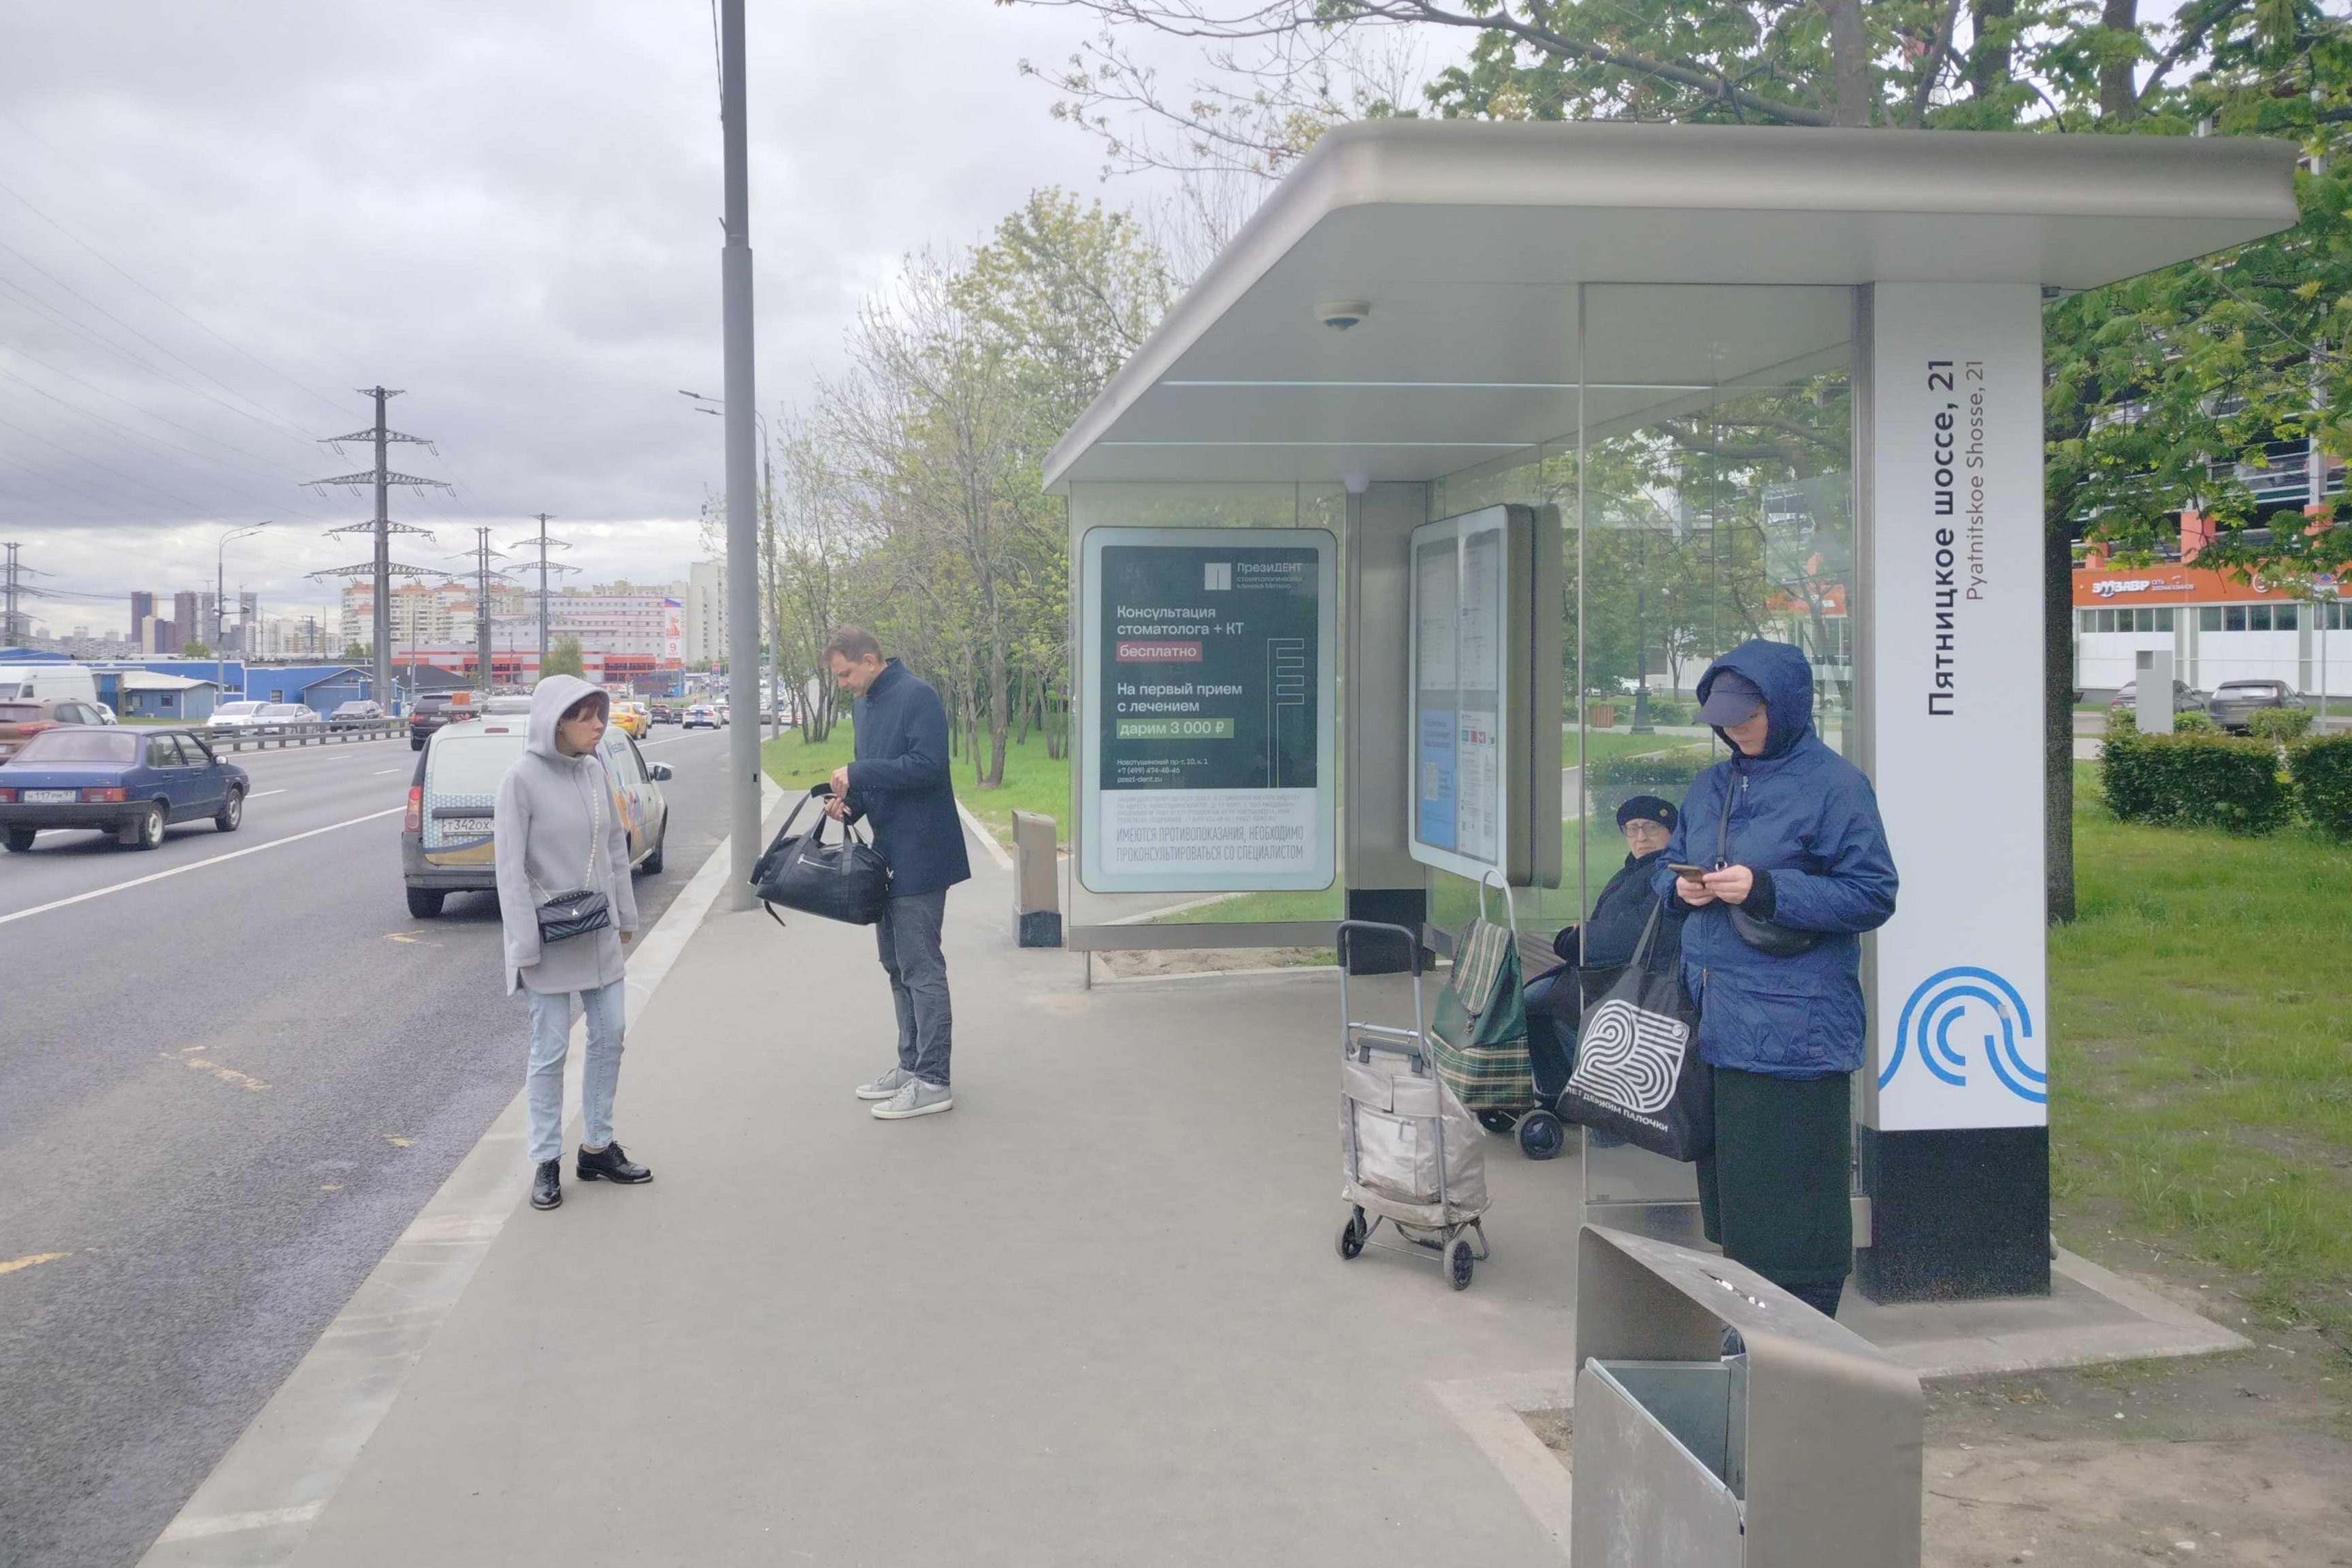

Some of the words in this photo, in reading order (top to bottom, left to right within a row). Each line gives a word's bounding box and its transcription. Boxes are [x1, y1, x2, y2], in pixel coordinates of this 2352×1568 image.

[1928, 361, 1953, 391] 21
[1965, 361, 1983, 380] 21
[1965, 387, 1986, 468] Shosse,
[1934, 403, 1959, 515] шоссе,
[1965, 476, 1987, 600] Pyatnitskoe
[1237, 562, 1303, 575] ПрезиДЕНТ
[1117, 606, 1216, 619] Консультация
[1928, 527, 1958, 715] Пятницкое
[1117, 624, 1209, 635] стоматолога
[1226, 622, 1244, 634] КТ
[1120, 644, 1197, 657] бесплатно
[1117, 683, 1135, 695] На
[1139, 683, 1193, 698] первый
[1196, 684, 1242, 697] прием
[1117, 702, 1126, 712] с
[1130, 701, 1200, 712] лечением
[1120, 723, 1166, 736] дарим
[1117, 827, 1156, 843] ИМЕЮТСЯ
[1159, 826, 1246, 843] ПРОТИВОПОКАЗАНИЯ,
[1249, 826, 1303, 842] НЕОБХОДИМО
[1117, 846, 1222, 862] ПРОКОНСУЛЬТИРОВАТЬСЯ
[1224, 845, 1235, 860] СО
[1237, 845, 1303, 862] СПЕЦИАЛИСТОМ
[1582, 1093, 1622, 1114] ДЕРЖИМ
[1623, 1109, 1669, 1133] ПАЛОЧКИ
